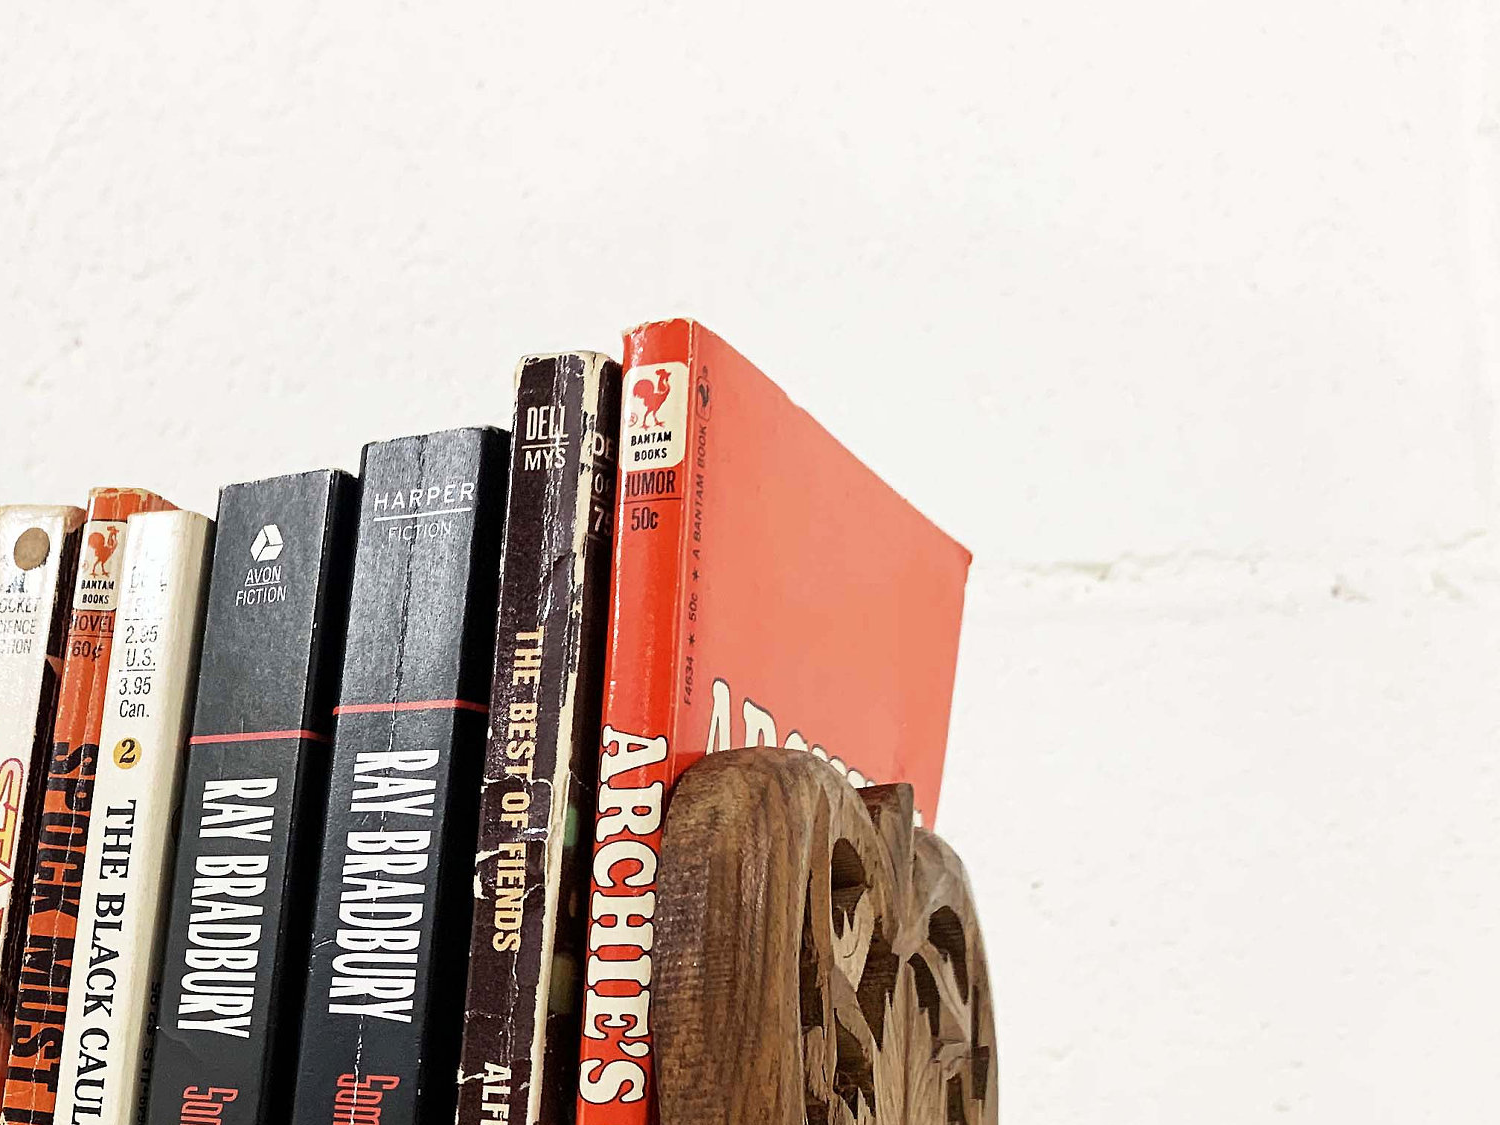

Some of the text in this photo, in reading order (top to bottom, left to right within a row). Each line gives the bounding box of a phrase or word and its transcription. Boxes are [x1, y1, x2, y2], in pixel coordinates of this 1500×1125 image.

[525, 405, 569, 442] DELL
[631, 431, 672, 446] BANTAM
[524, 448, 566, 471] MYS
[634, 447, 668, 462] BOOKS
[374, 482, 476, 512] HARPER
[387, 520, 452, 541] FICTION
[244, 564, 282, 584] AVON
[682, 424, 707, 706] F4634 A BANTAM BOOK
[81, 580, 115, 591] BANTAM
[236, 585, 287, 606] FICTION
[82, 594, 110, 605] BOOKS
[126, 648, 156, 668] U.S.
[119, 676, 152, 696] 3.95
[119, 700, 150, 718] Can.
[119, 739, 137, 764] 2
[492, 625, 545, 953] THE BEST OF FIENDS
[29, 741, 99, 919] SPOCK
[99, 799, 137, 880] THE
[328, 749, 440, 1024] RAY BRADBURY
[177, 777, 278, 1039] RAY BRADBURY
[579, 725, 668, 1104] ARCHIE'S
[83, 892, 126, 1018] BLACK
[8, 935, 76, 1093] MUST
